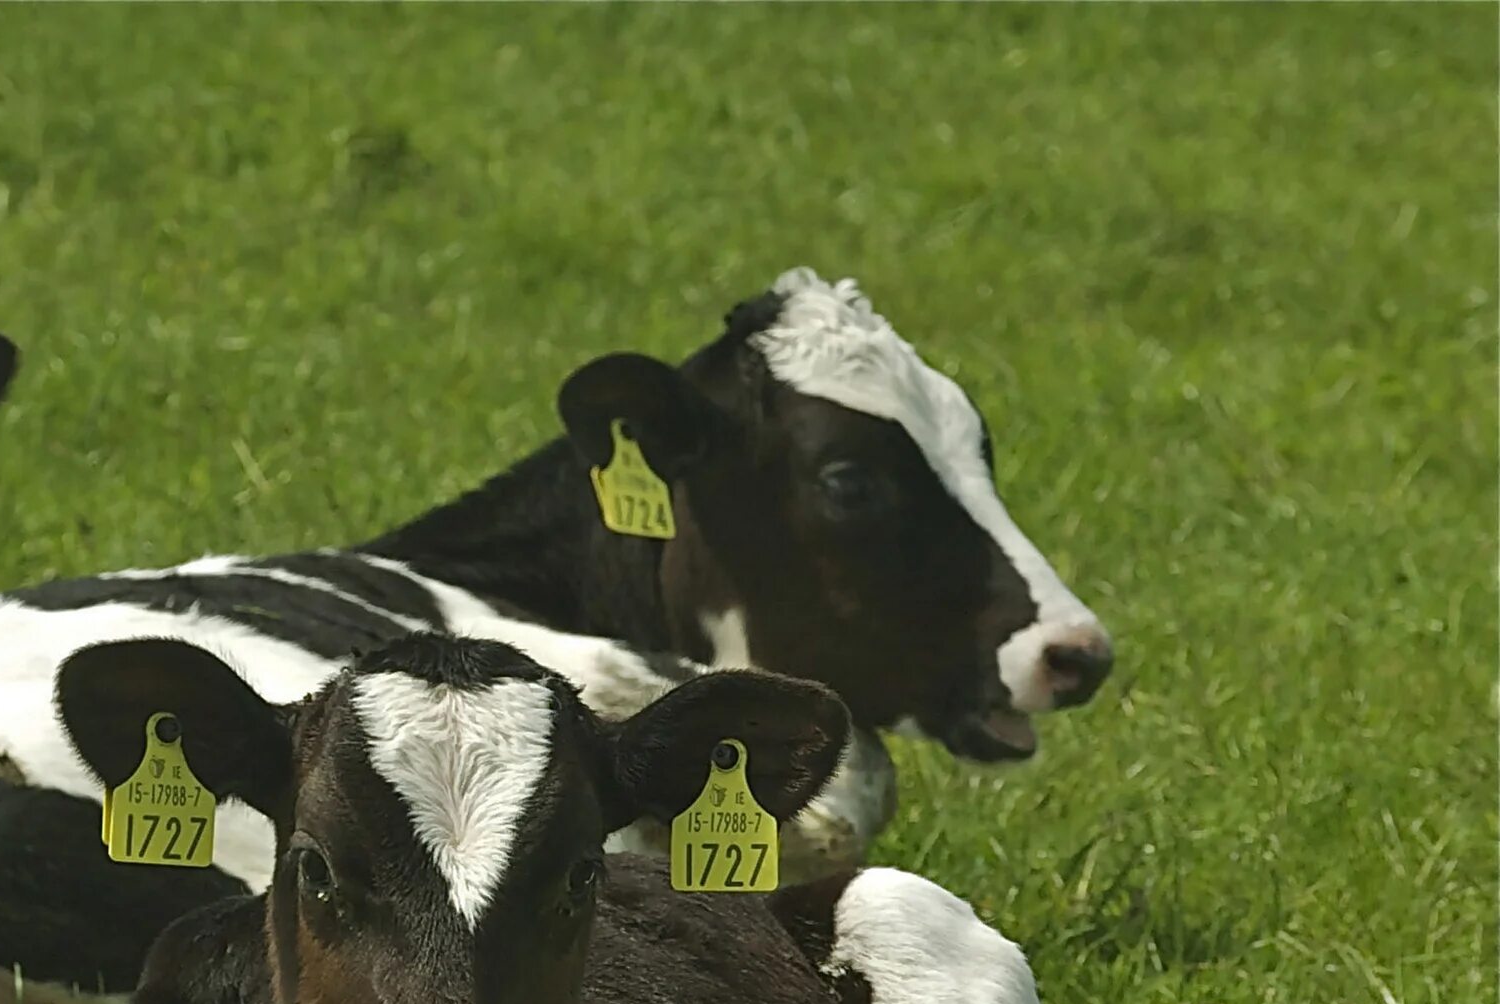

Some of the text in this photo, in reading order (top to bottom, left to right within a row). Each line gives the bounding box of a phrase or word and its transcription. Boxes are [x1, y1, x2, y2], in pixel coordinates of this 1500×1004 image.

[128, 782, 202, 807] 15-17988-7
[125, 814, 208, 861] 1727
[688, 812, 762, 833] 15-17988-7
[686, 843, 769, 887] 1727
